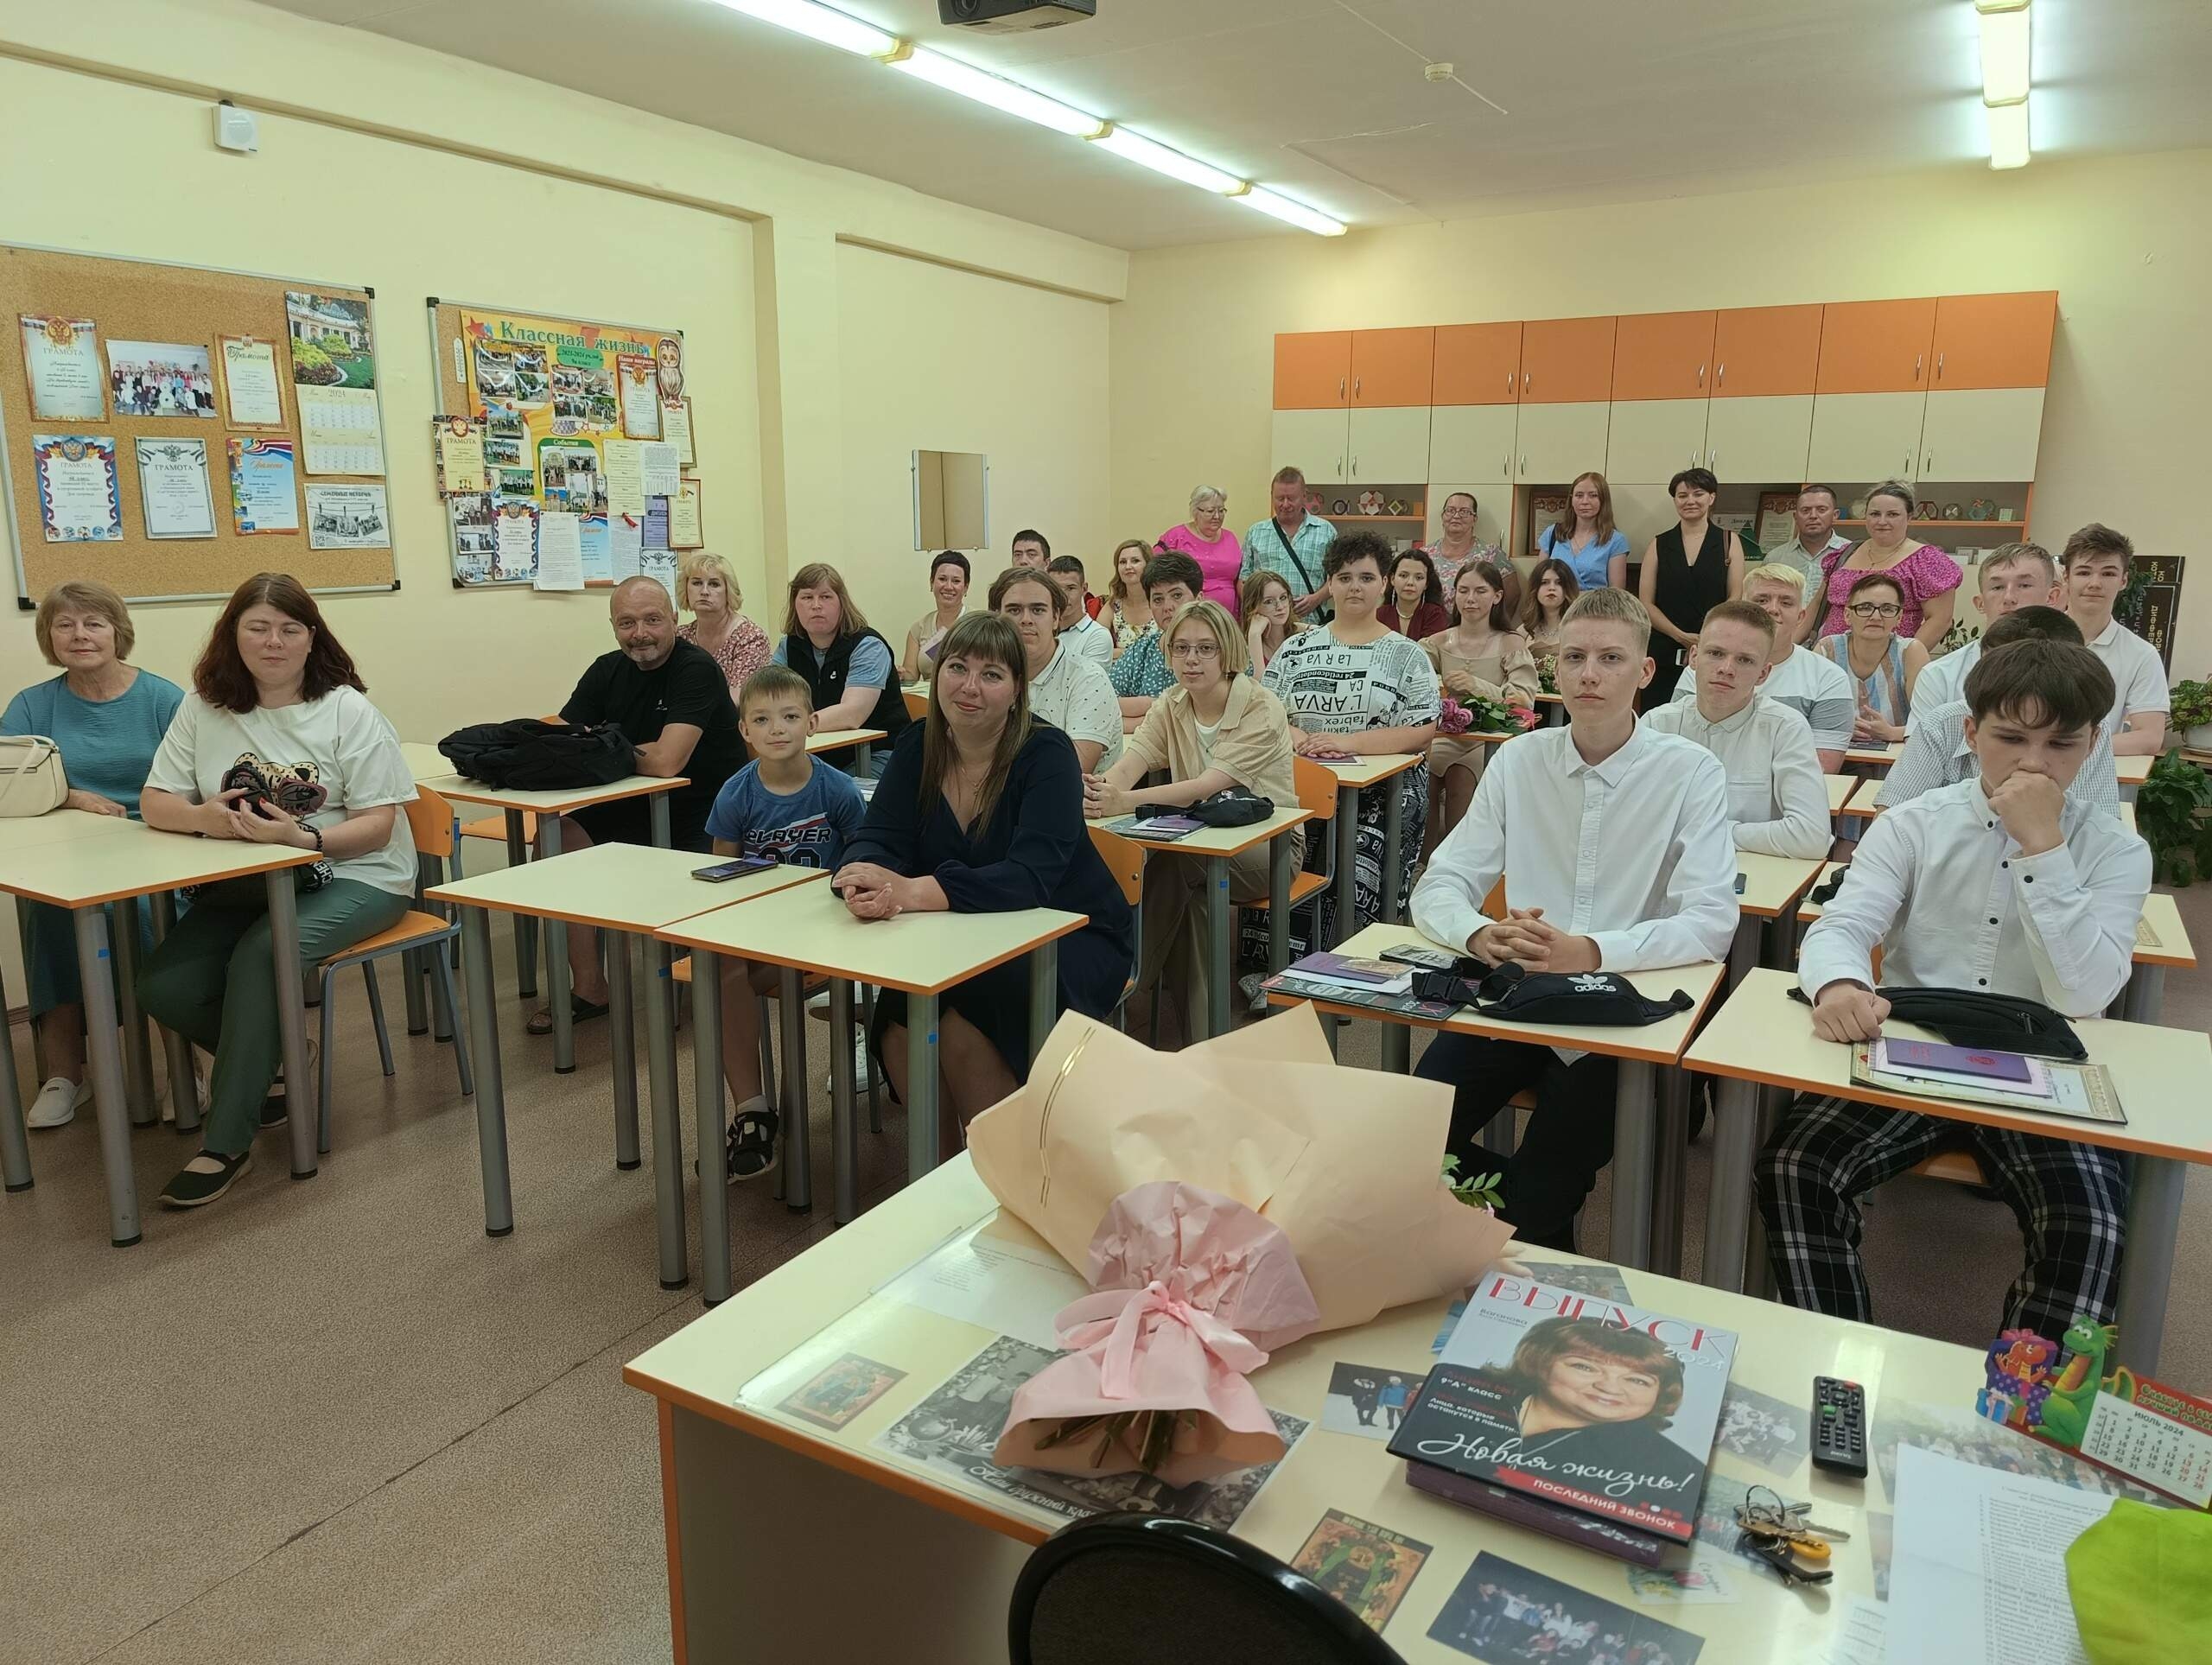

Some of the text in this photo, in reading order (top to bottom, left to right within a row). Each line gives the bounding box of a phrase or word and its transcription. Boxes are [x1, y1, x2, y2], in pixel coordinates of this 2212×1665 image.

[500, 321, 645, 355] Классная жизнь
[2147, 605, 2158, 644] ДИФФЕР
[1325, 716, 1364, 726] fabrex
[746, 827, 832, 844] PLAYER
[1574, 980, 1618, 993] adidas
[1489, 1277, 1727, 1358] ВЫПУСК
[1663, 1346, 1723, 1371] 2024
[1467, 1386, 1503, 1401] класс
[1427, 1402, 1473, 1420] останутся
[1456, 1405, 1496, 1420] которые
[2134, 1410, 2184, 1437] ИЮЛЬ 2024
[1417, 1433, 1695, 1497] Новая жизнь!
[2099, 1448, 2108, 1457] 29
[2113, 1455, 2123, 1464] 30
[2129, 1461, 2139, 1470] 31
[2116, 1447, 2126, 1456] 23
[2131, 1453, 2140, 1462] 24
[2146, 1460, 2156, 1469] 25
[2162, 1467, 2171, 1476] 26
[2177, 1473, 2187, 1482] 27
[2118, 1439, 2127, 1448] 16
[2148, 1452, 2158, 1461] 18
[2164, 1459, 2174, 1468] 19
[2179, 1466, 2190, 1475] 20
[2196, 1473, 2205, 1482] 21
[2151, 1445, 2159, 1453] 11
[2166, 1452, 2176, 1460] 12
[2182, 1458, 2192, 1467] 13
[969, 1460, 1010, 1488] Наш
[1009, 1484, 1065, 1510] дружный
[1534, 1478, 1676, 1529] ПОСЛЕДНИЙ ЗВОНОК
